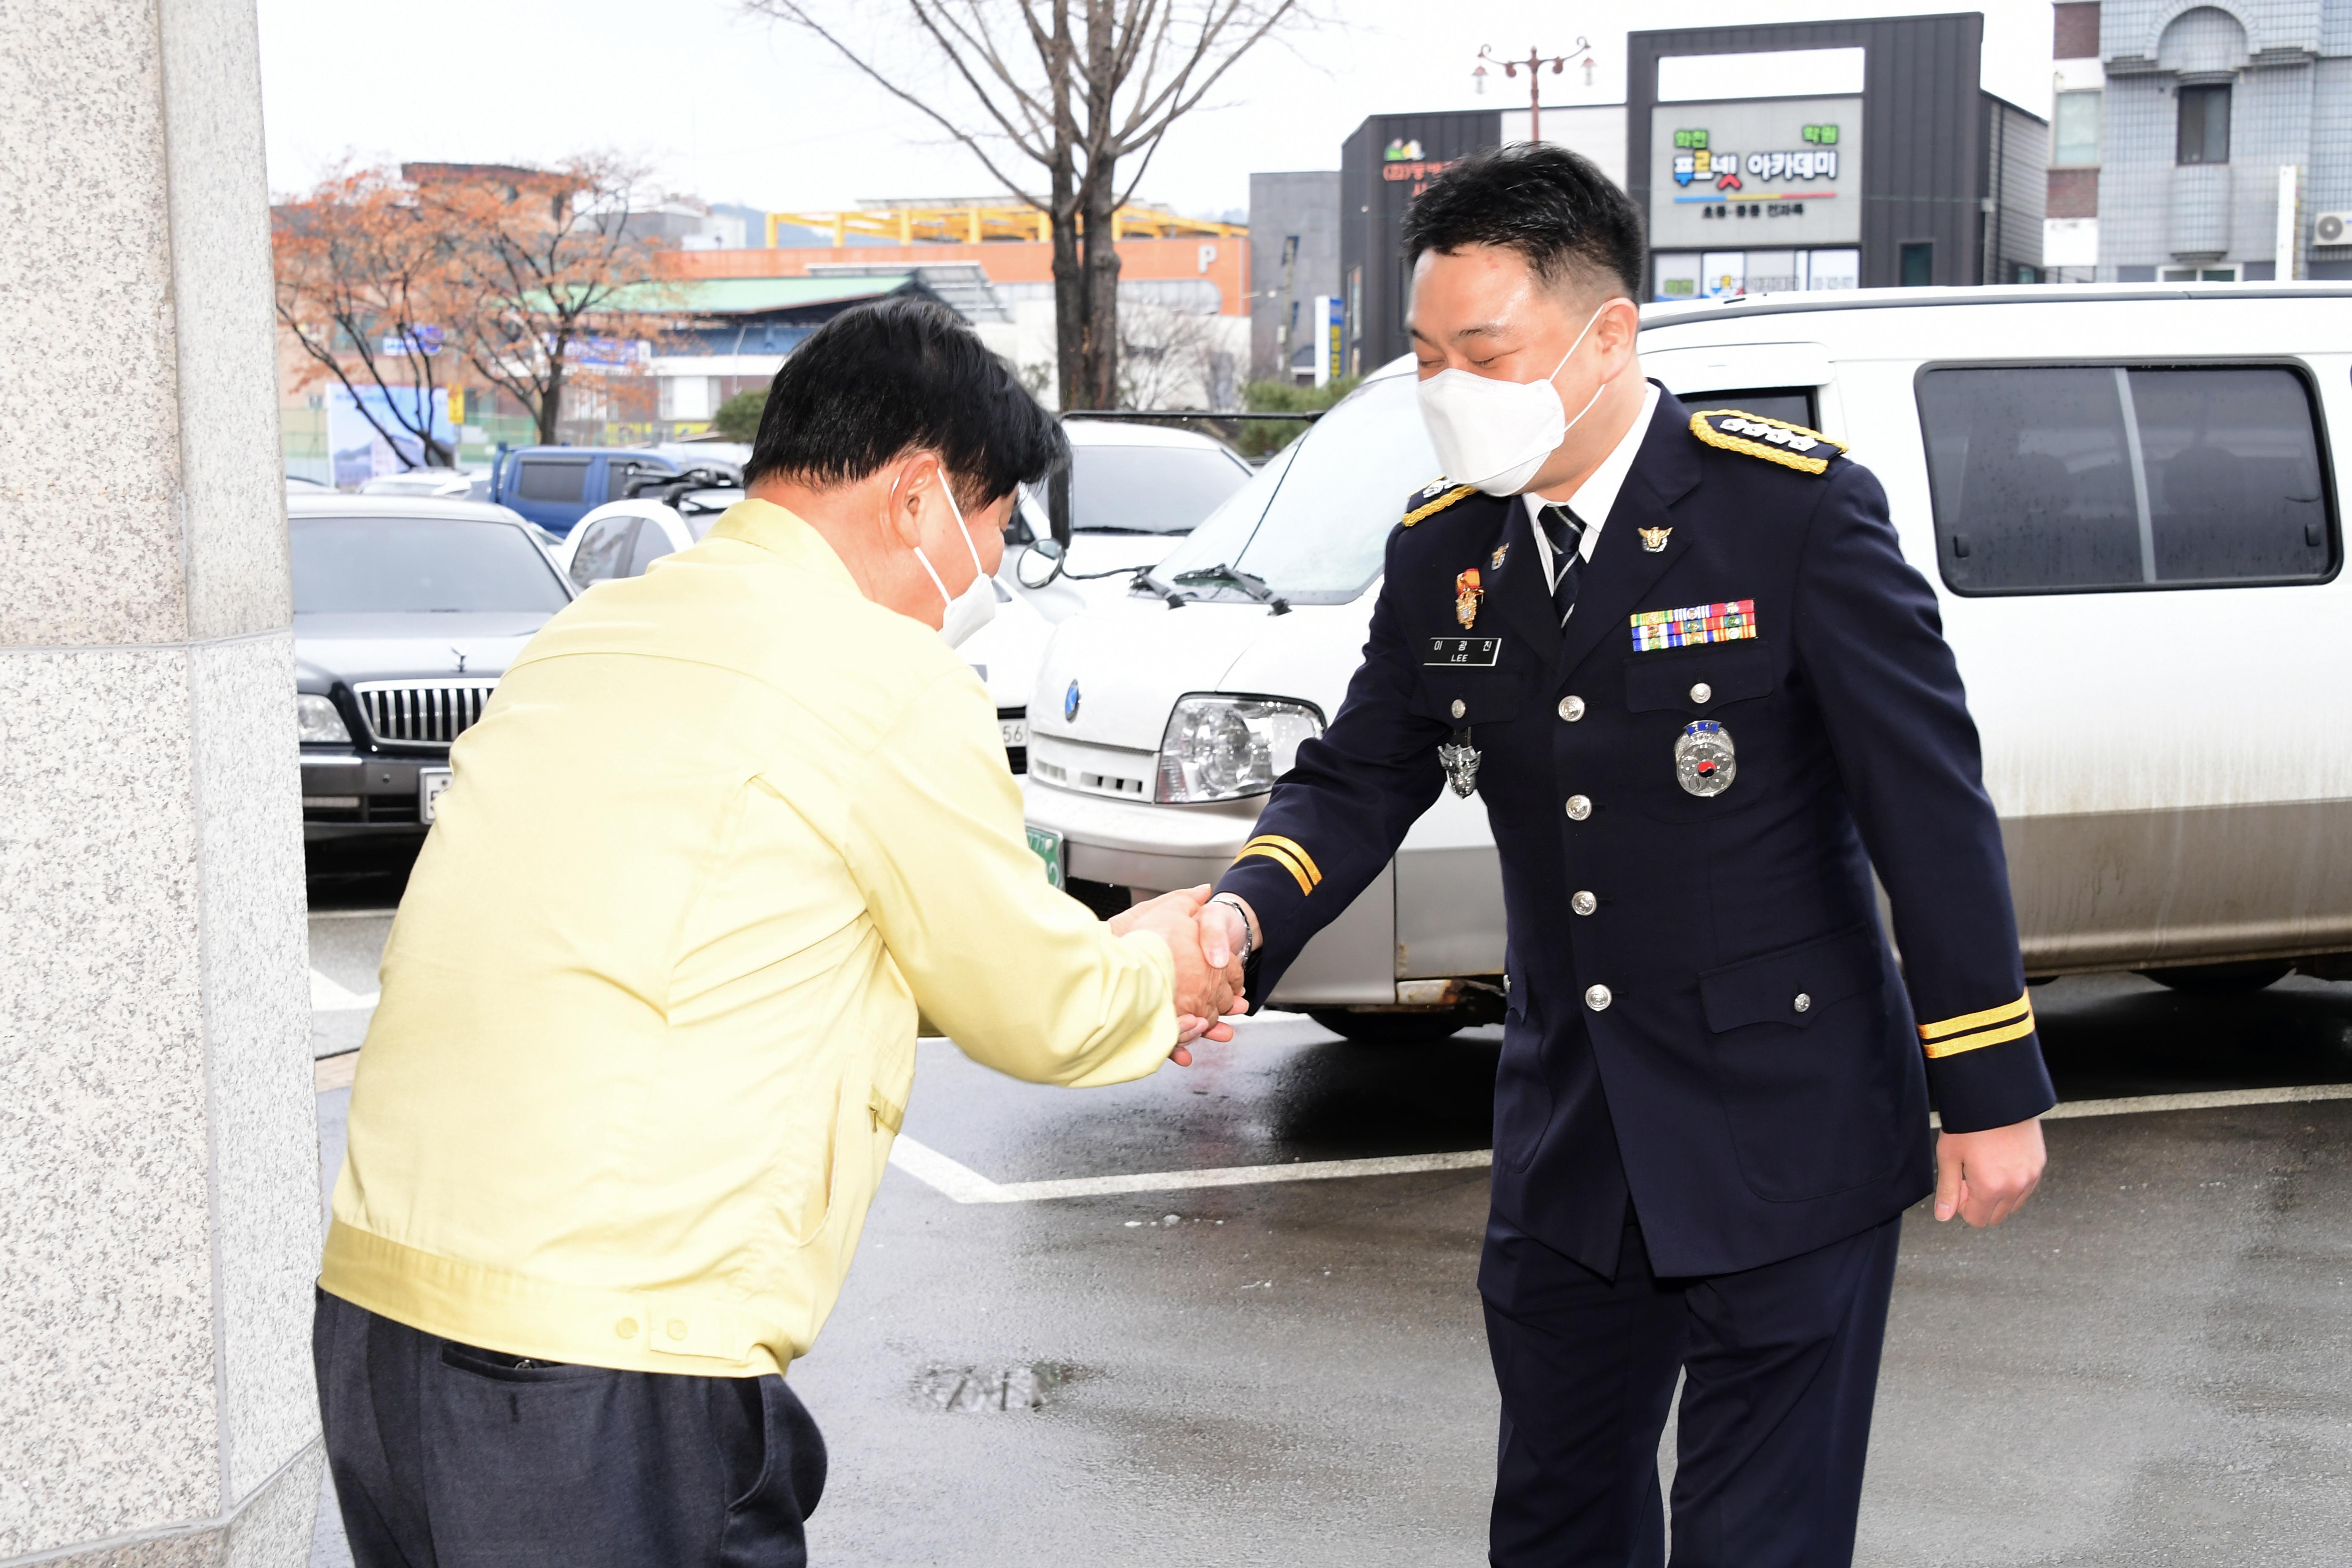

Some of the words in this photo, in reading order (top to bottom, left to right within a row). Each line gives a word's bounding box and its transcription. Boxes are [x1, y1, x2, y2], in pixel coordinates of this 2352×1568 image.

[1674, 149, 1742, 190] 푸르넷
[1747, 150, 1838, 180] 아카데미
[1199, 245, 1217, 273] P
[1451, 654, 1468, 662] LEE
